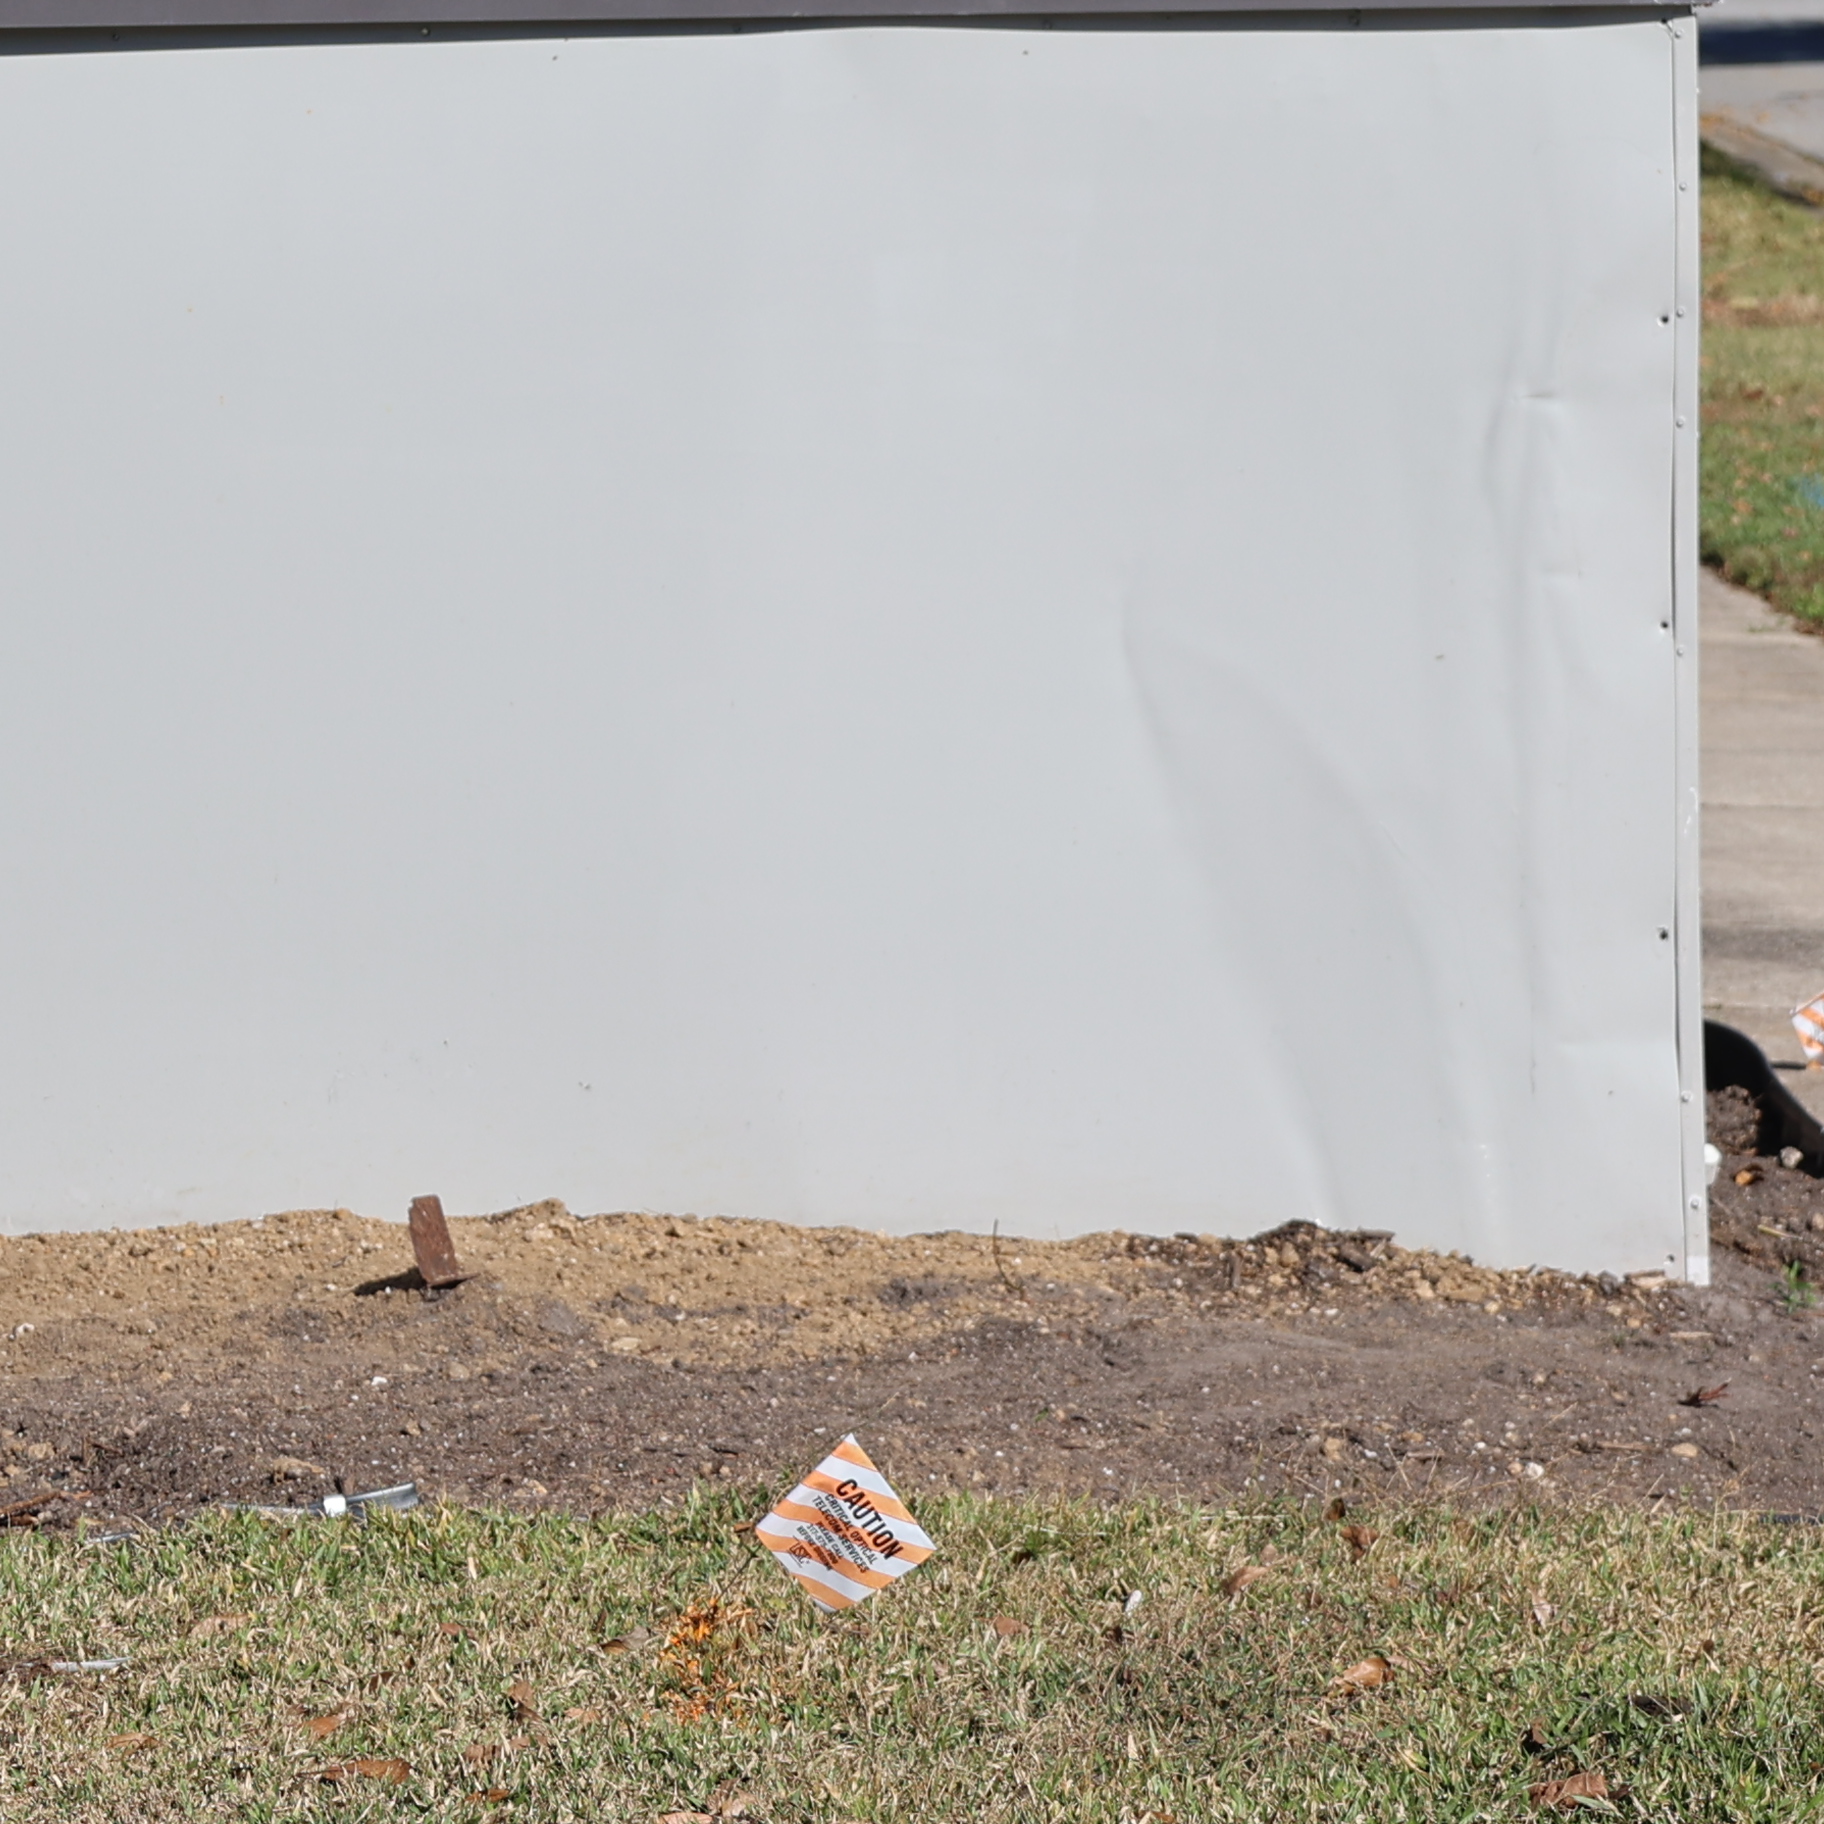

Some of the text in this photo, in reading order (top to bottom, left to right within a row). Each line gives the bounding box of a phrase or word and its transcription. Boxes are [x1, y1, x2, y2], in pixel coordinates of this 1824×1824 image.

[812, 1495, 869, 1573] TELECOM SERVICES
[815, 1520, 844, 1559] PLEASE CALL
[824, 1492, 877, 1564] CRITICAL OPTICAL
[835, 1478, 903, 1560] CAUTION
